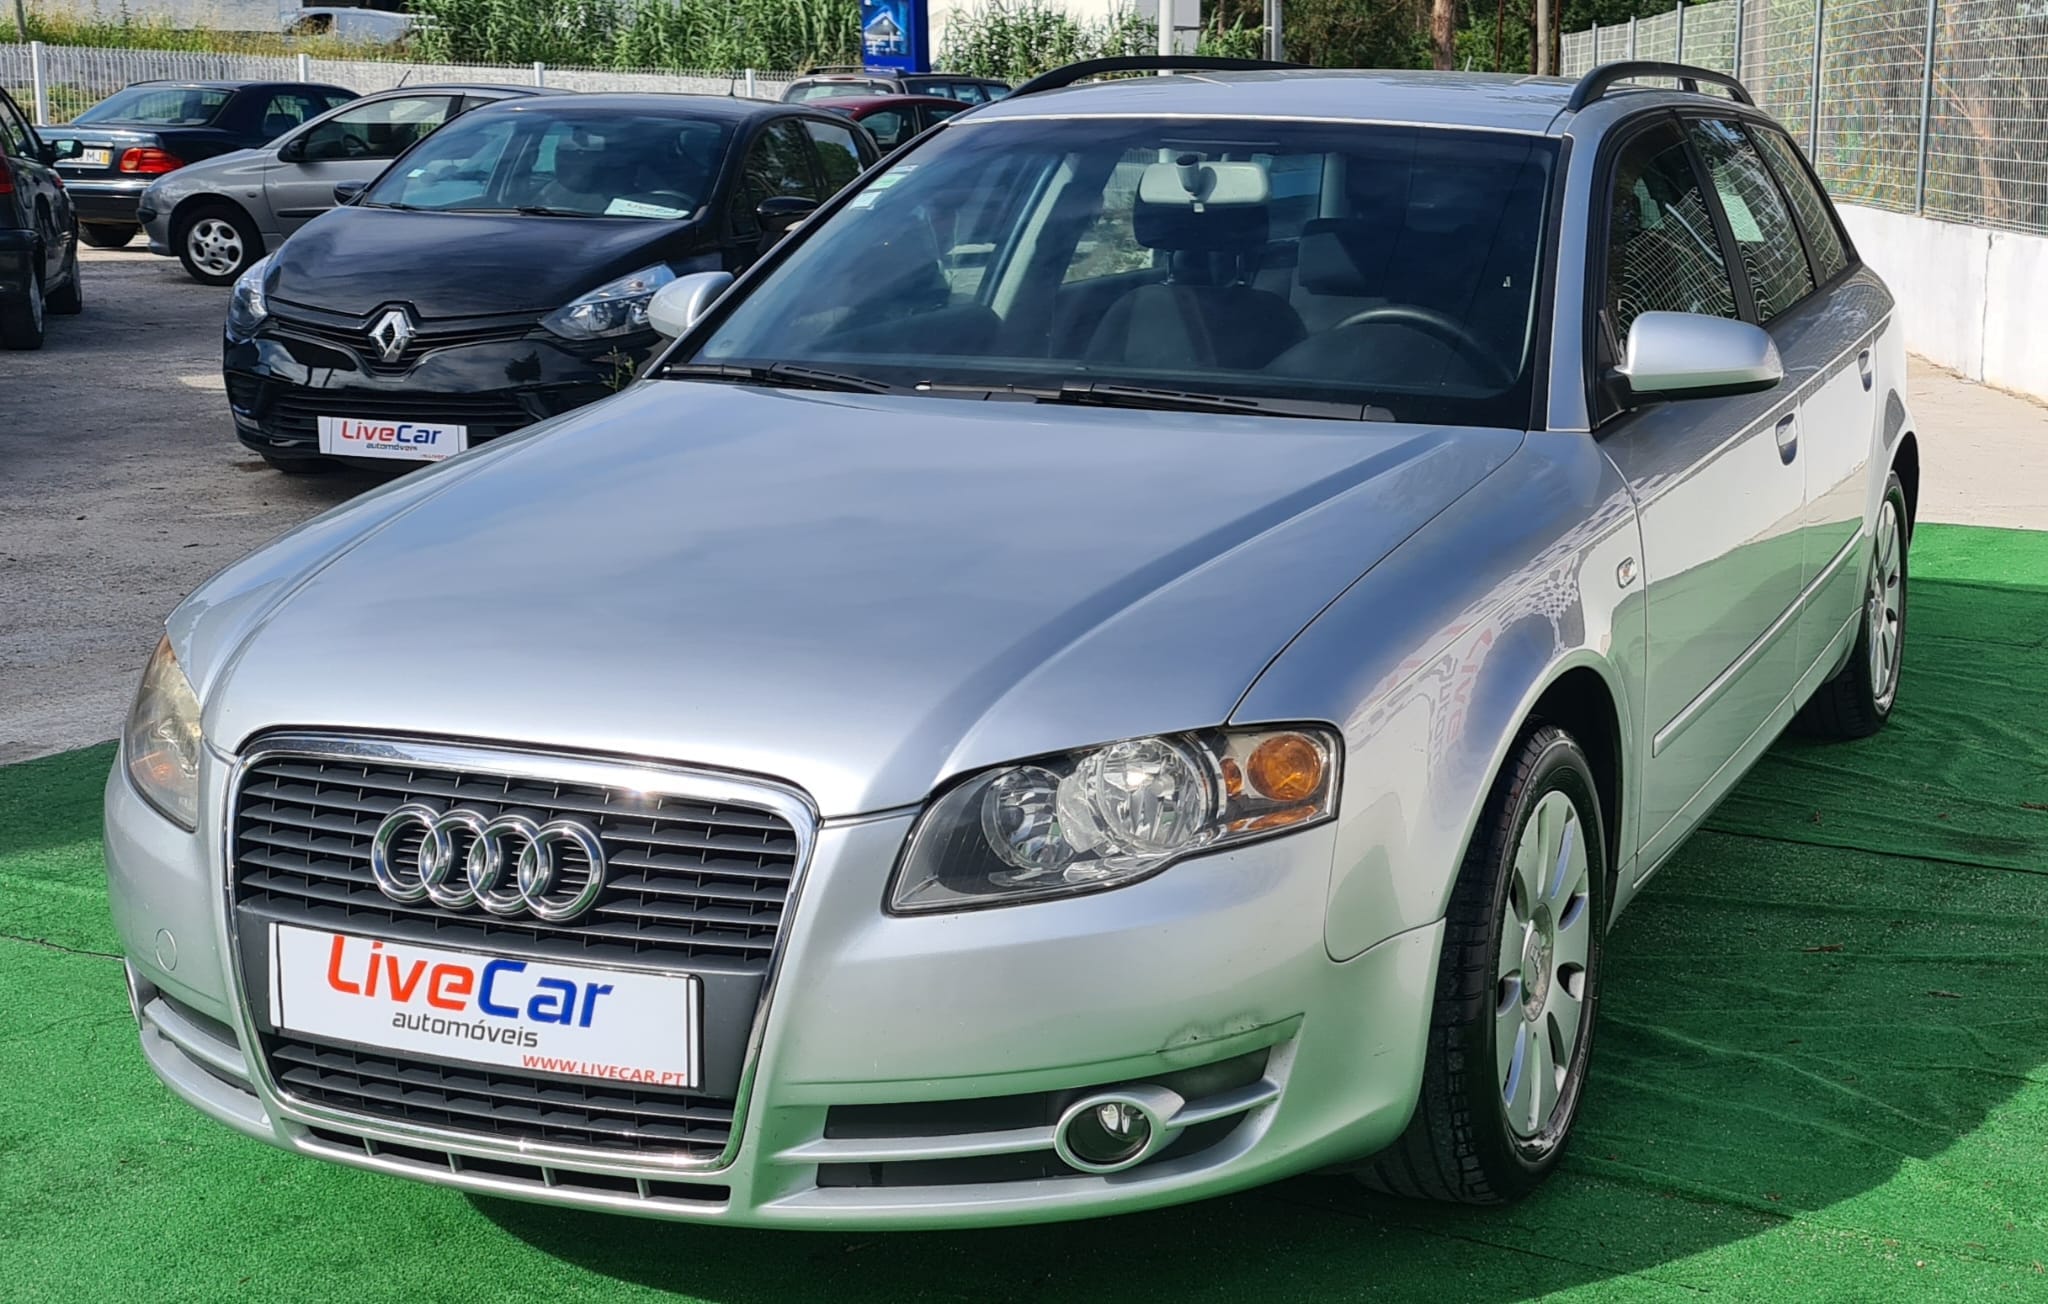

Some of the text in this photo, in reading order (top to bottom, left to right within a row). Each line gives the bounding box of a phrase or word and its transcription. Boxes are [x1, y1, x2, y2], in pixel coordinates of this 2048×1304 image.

[341, 420, 443, 445] LiveCar
[327, 934, 614, 1028] LiveCar
[392, 1012, 538, 1048] automóveis
[522, 1054, 685, 1087] WWW.LIVECAR.PT
